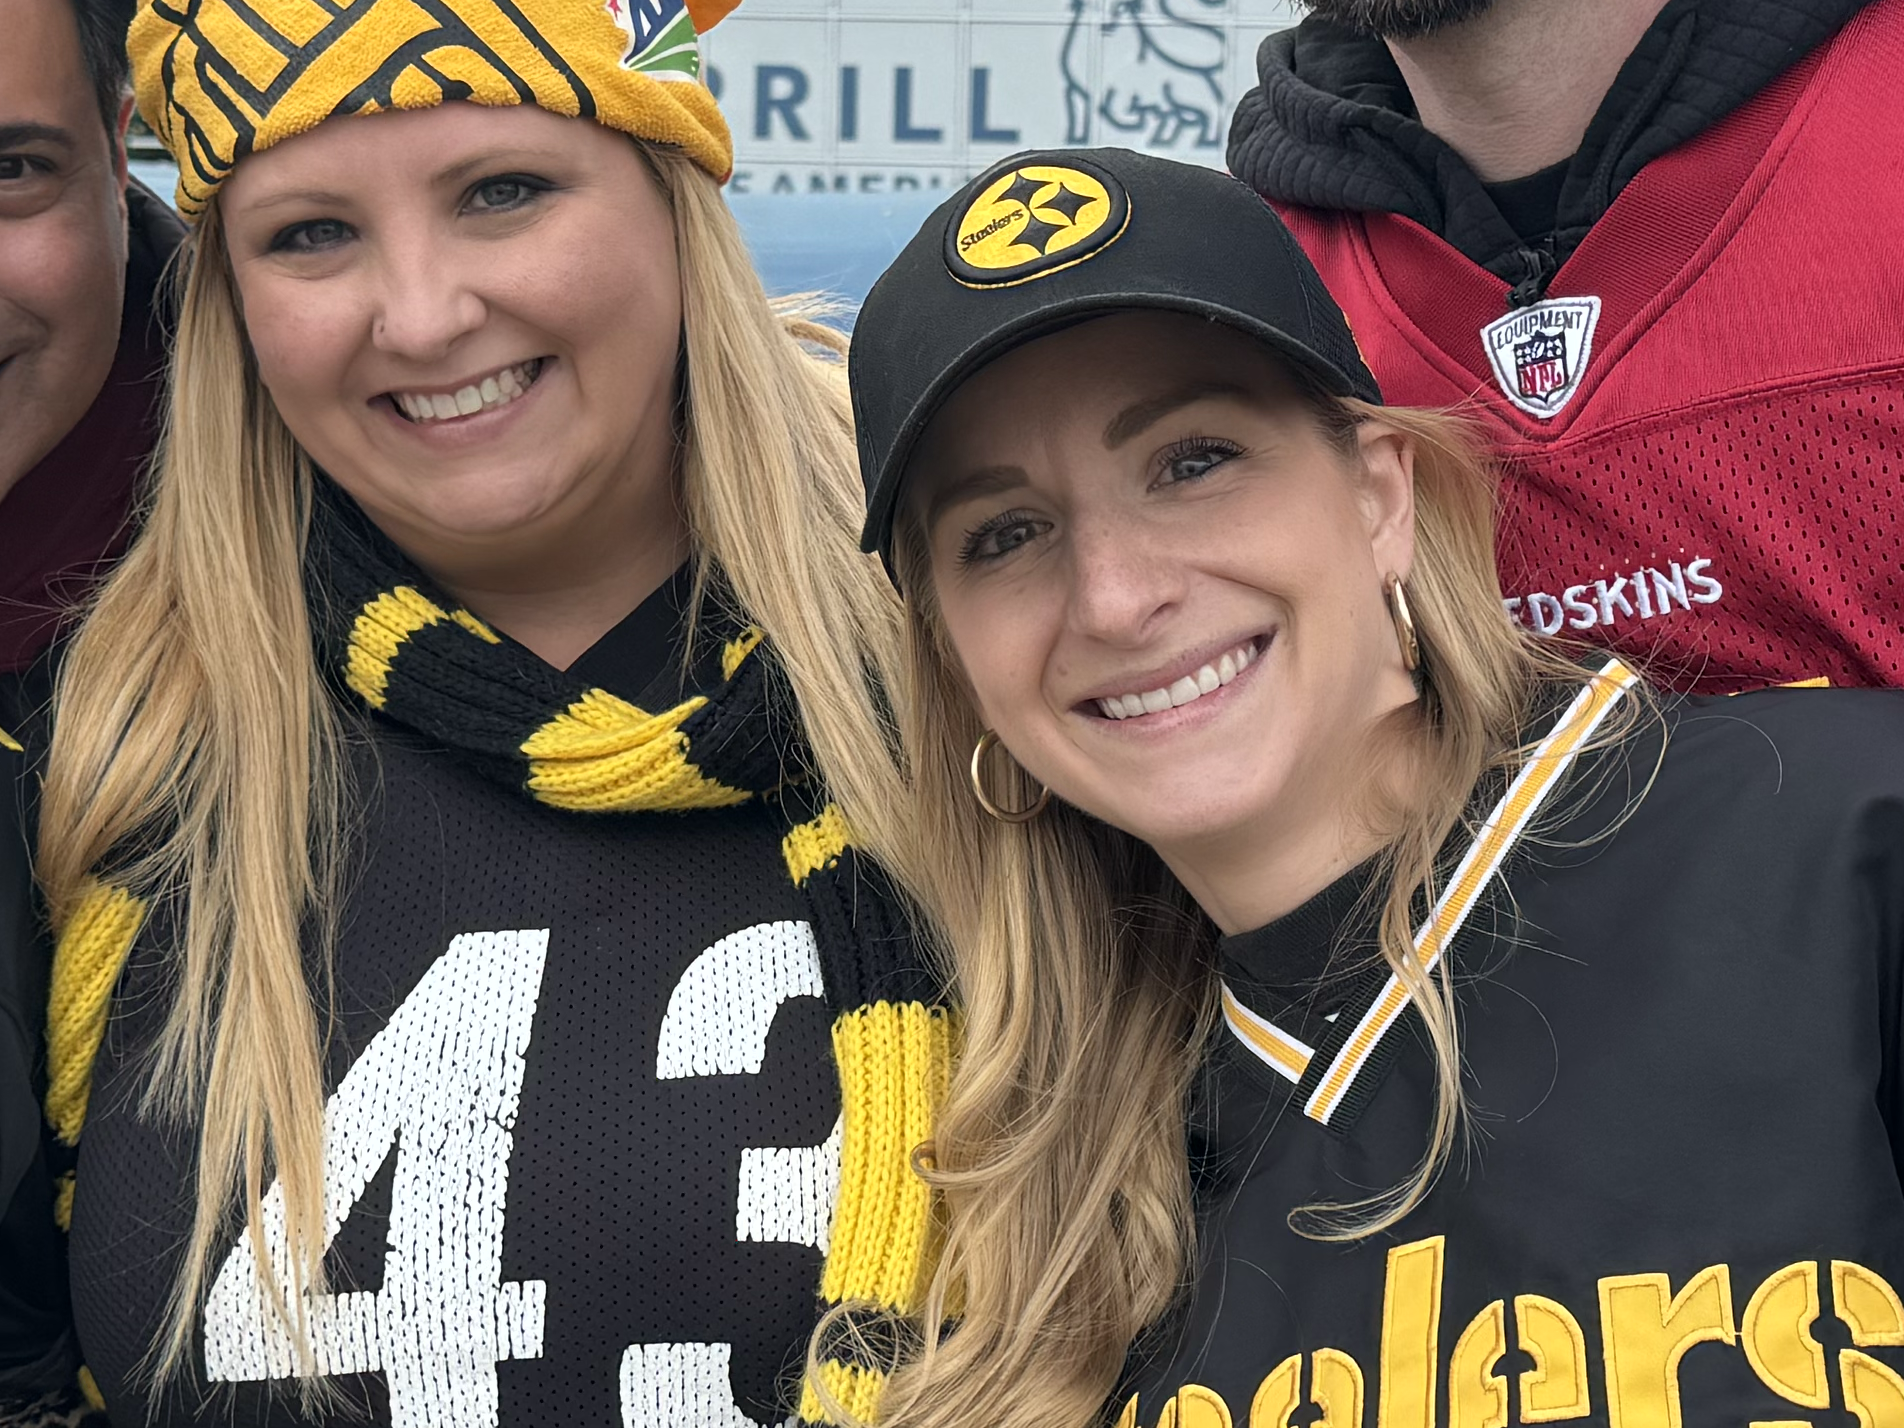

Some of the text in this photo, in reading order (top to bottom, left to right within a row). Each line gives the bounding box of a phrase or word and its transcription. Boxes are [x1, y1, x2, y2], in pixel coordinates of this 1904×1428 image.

[707, 63, 1022, 145] RILL
[1496, 309, 1583, 350] EQUIPMENT
[1520, 360, 1563, 395] NFL
